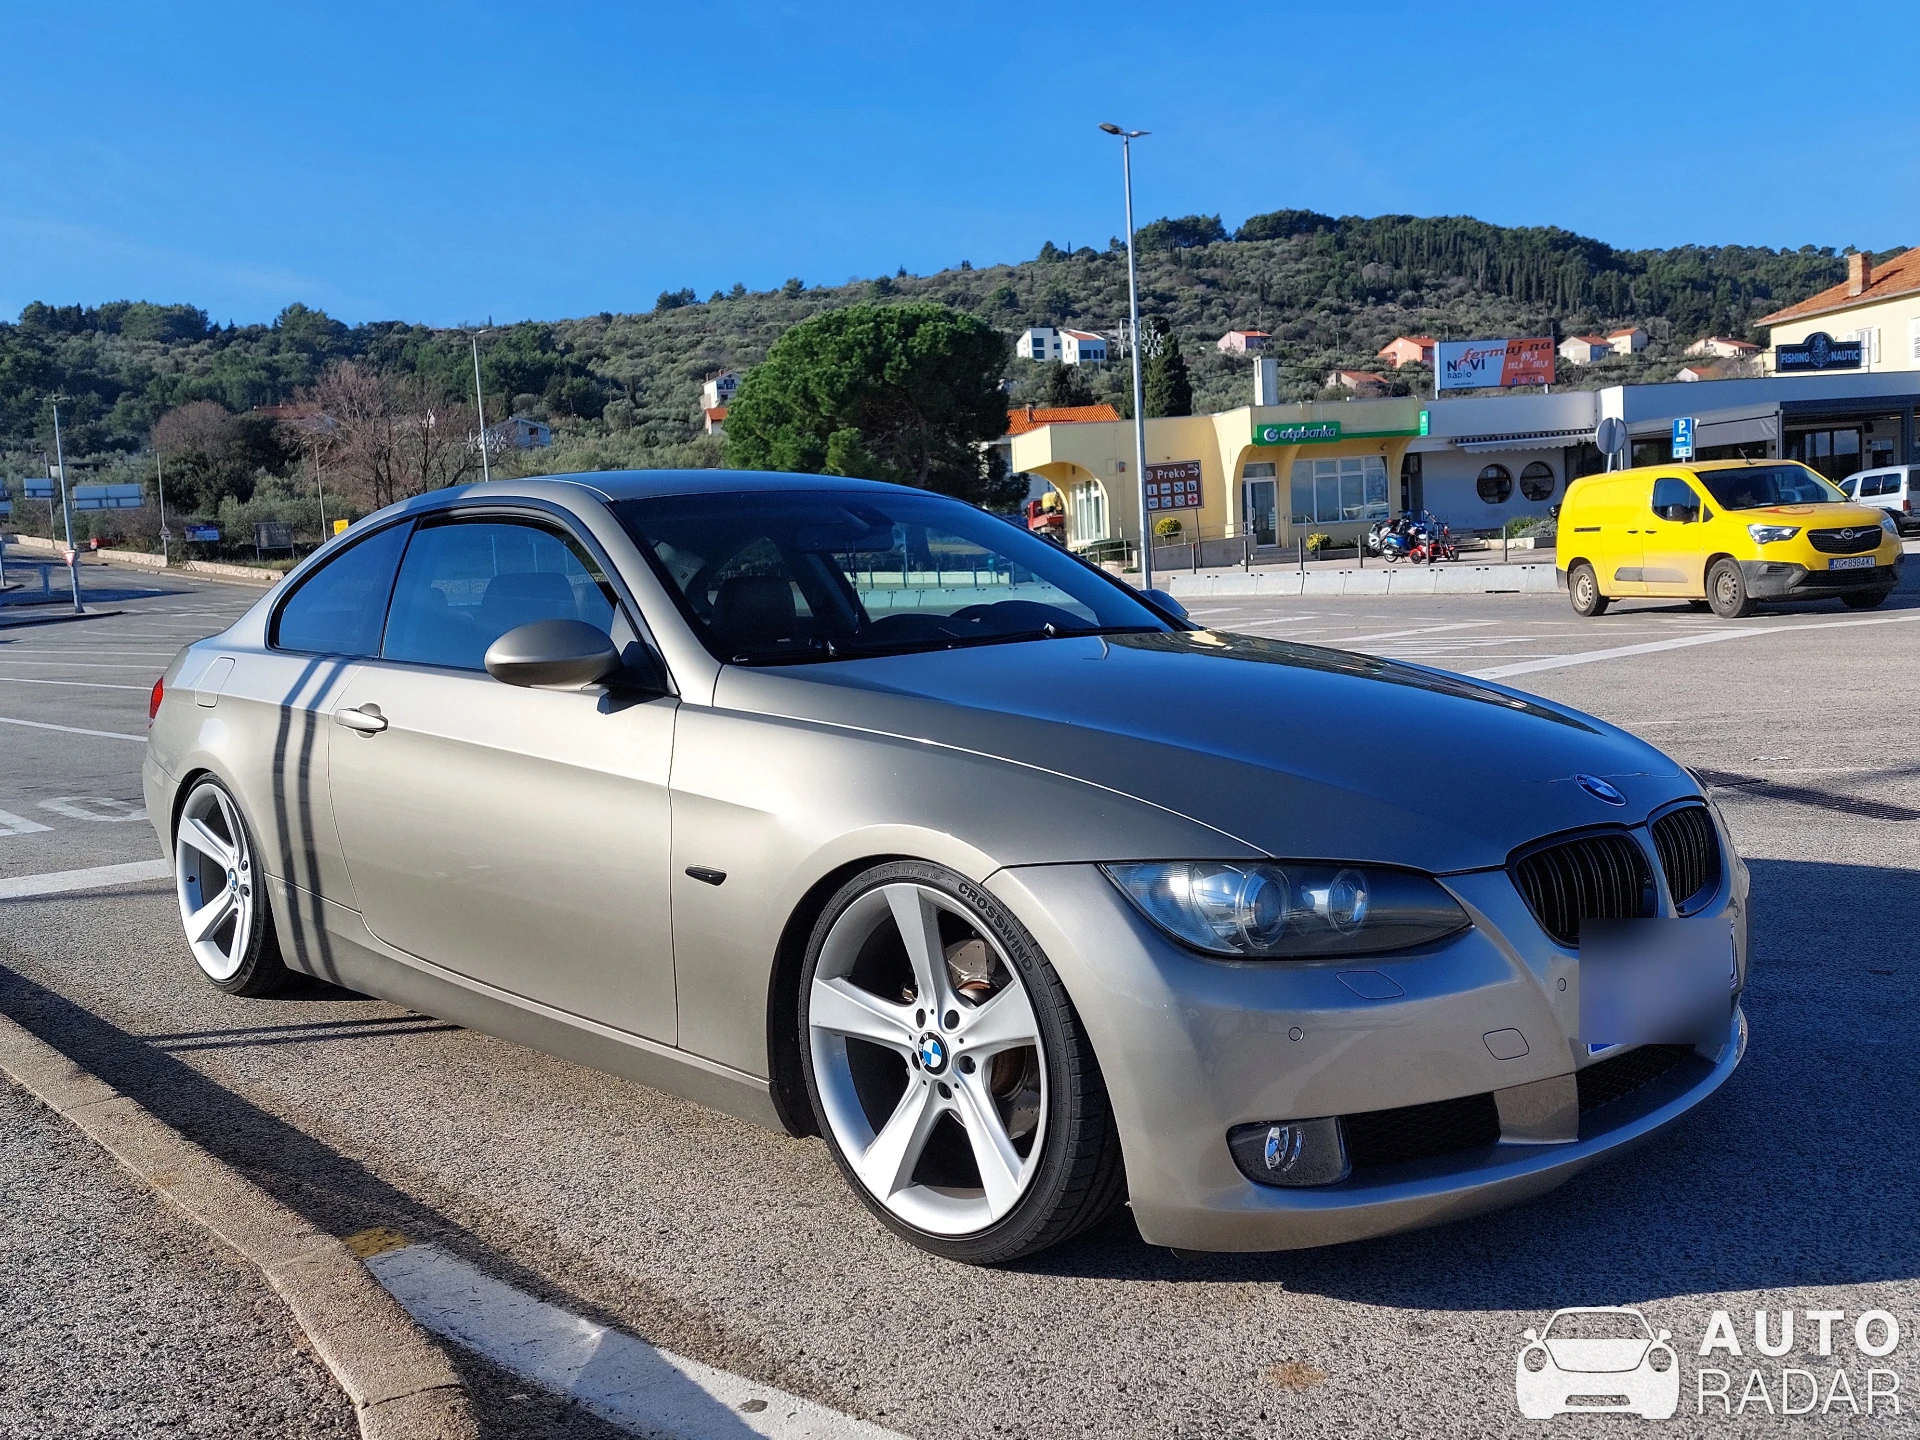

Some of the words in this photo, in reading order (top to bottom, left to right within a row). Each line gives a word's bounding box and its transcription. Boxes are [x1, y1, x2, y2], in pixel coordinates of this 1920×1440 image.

[1529, 341, 1551, 352] na
[1781, 352, 1809, 363] FISHING
[1831, 350, 1859, 360] NAUTIC
[1679, 420, 1686, 434] P
[1157, 468, 1186, 479] Preko
[1834, 560, 1844, 569] ZG
[958, 882, 1033, 971] CROSSWIND
